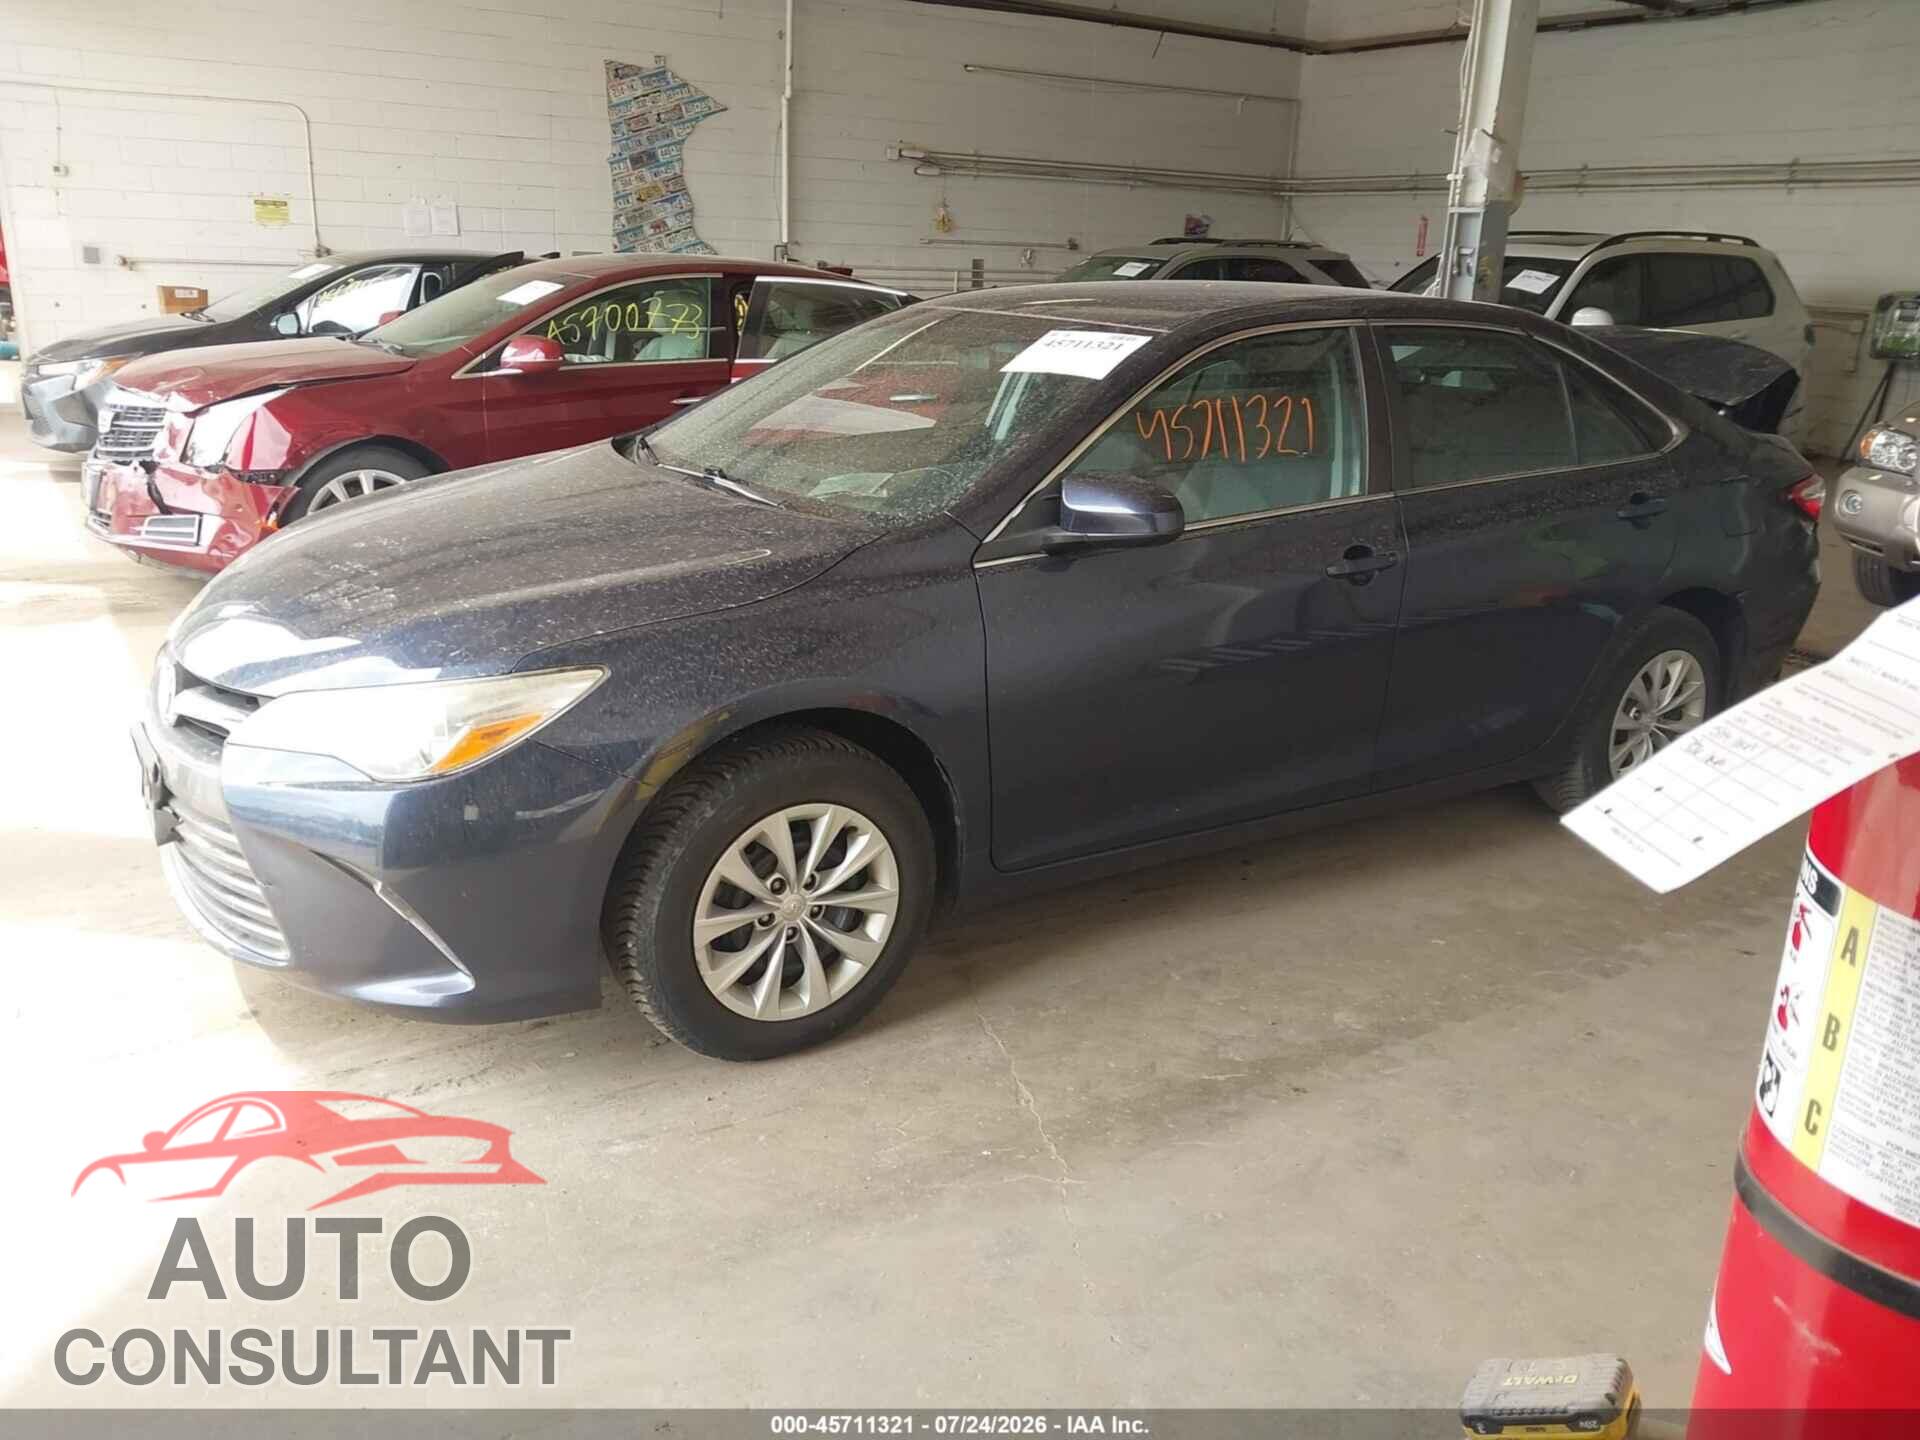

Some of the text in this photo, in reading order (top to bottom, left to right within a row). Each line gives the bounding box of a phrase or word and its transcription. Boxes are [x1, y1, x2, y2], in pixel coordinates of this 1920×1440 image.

[1135, 393, 1315, 464] 45711321
[1840, 925, 1859, 968] A
[1822, 1011, 1841, 1052] B
[1804, 1098, 1822, 1136] C
